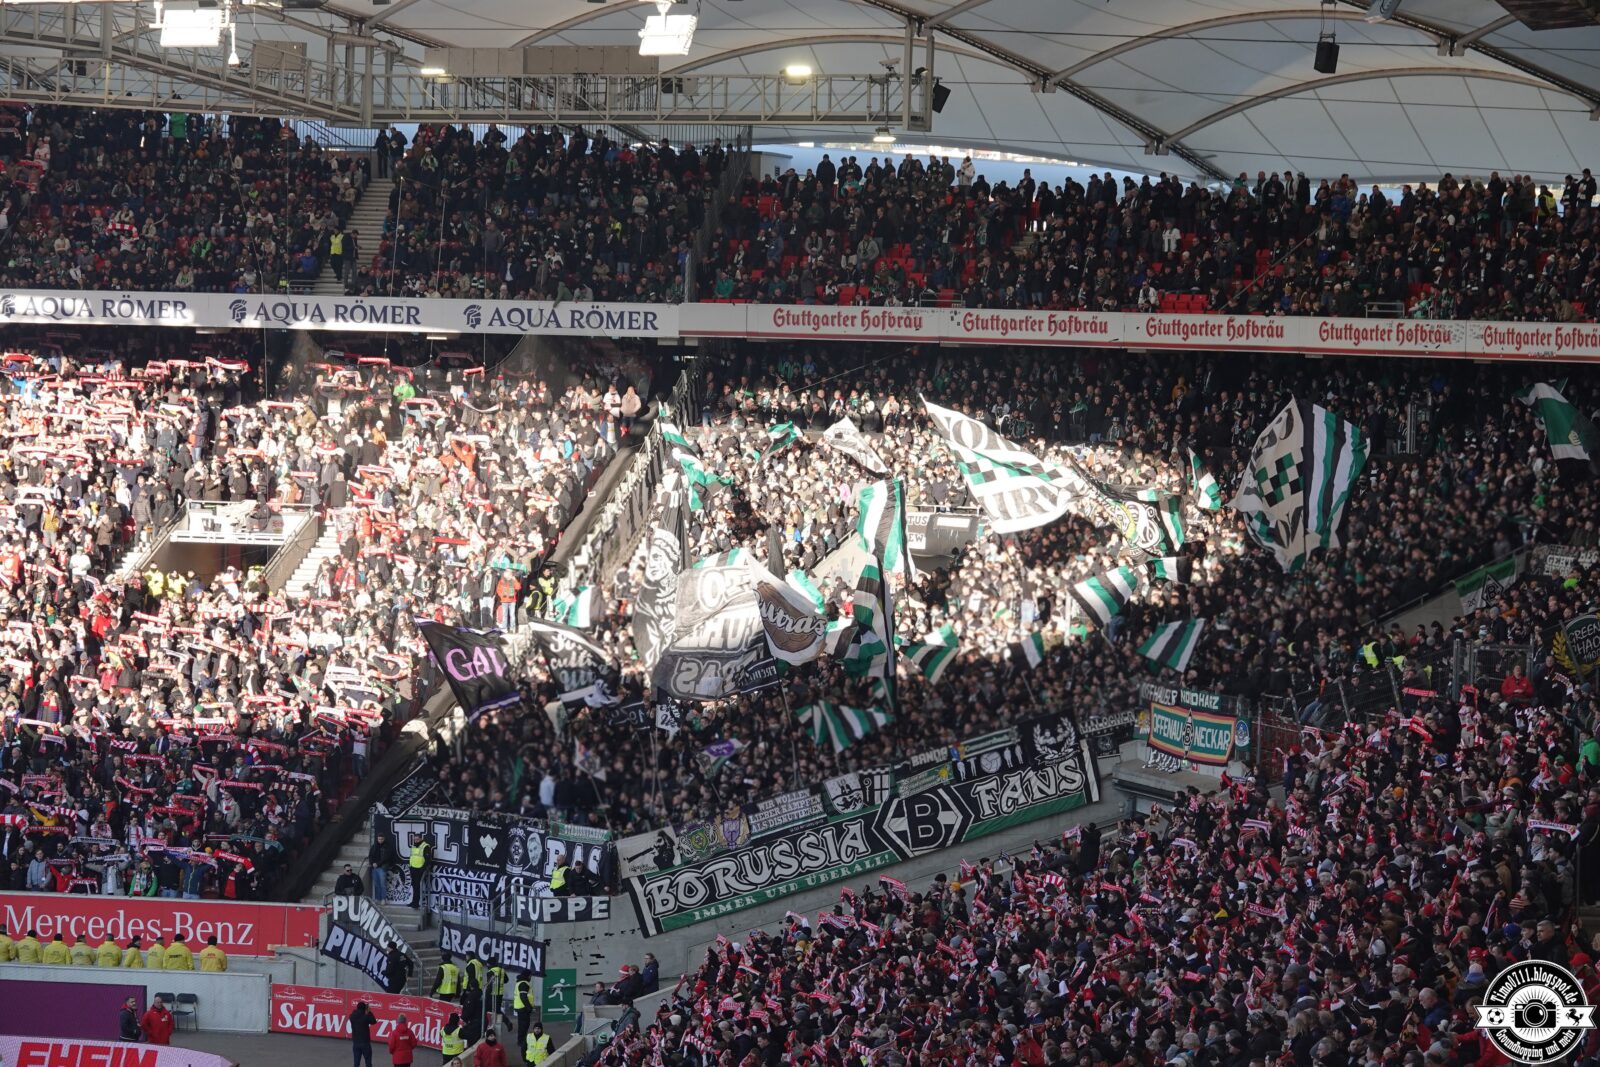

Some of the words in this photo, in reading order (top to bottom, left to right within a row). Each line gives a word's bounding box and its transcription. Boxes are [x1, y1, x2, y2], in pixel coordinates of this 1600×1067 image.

[23, 297, 99, 321] AQUA
[102, 295, 188, 319] RÖMER
[254, 302, 326, 325] AQUA
[335, 300, 421, 325] RÖMER
[488, 307, 569, 331] AQUA
[570, 305, 659, 330] RÖMER
[772, 308, 857, 331] Stuttgarter
[963, 312, 1044, 336] Stuttgarter
[1047, 313, 1108, 337] Hofbräu
[1146, 317, 1222, 341] Stuttgarter
[1226, 317, 1284, 339] Hofbräu
[1319, 320, 1392, 345] Stuttgarter
[1396, 322, 1452, 345] Hofbräu
[1483, 324, 1551, 348] Stuttgarter
[1152, 713, 1183, 742] OFFENAU
[1194, 727, 1231, 751] NECKAR
[644, 819, 872, 918] BORUSSIA
[971, 757, 1085, 820] FANS
[693, 896, 756, 921] IMMER
[766, 882, 797, 899] UND
[806, 854, 890, 887] ÜBERALL!
[5, 904, 254, 945] Mercedes-Benz
[441, 926, 541, 972] BRACHELEN
